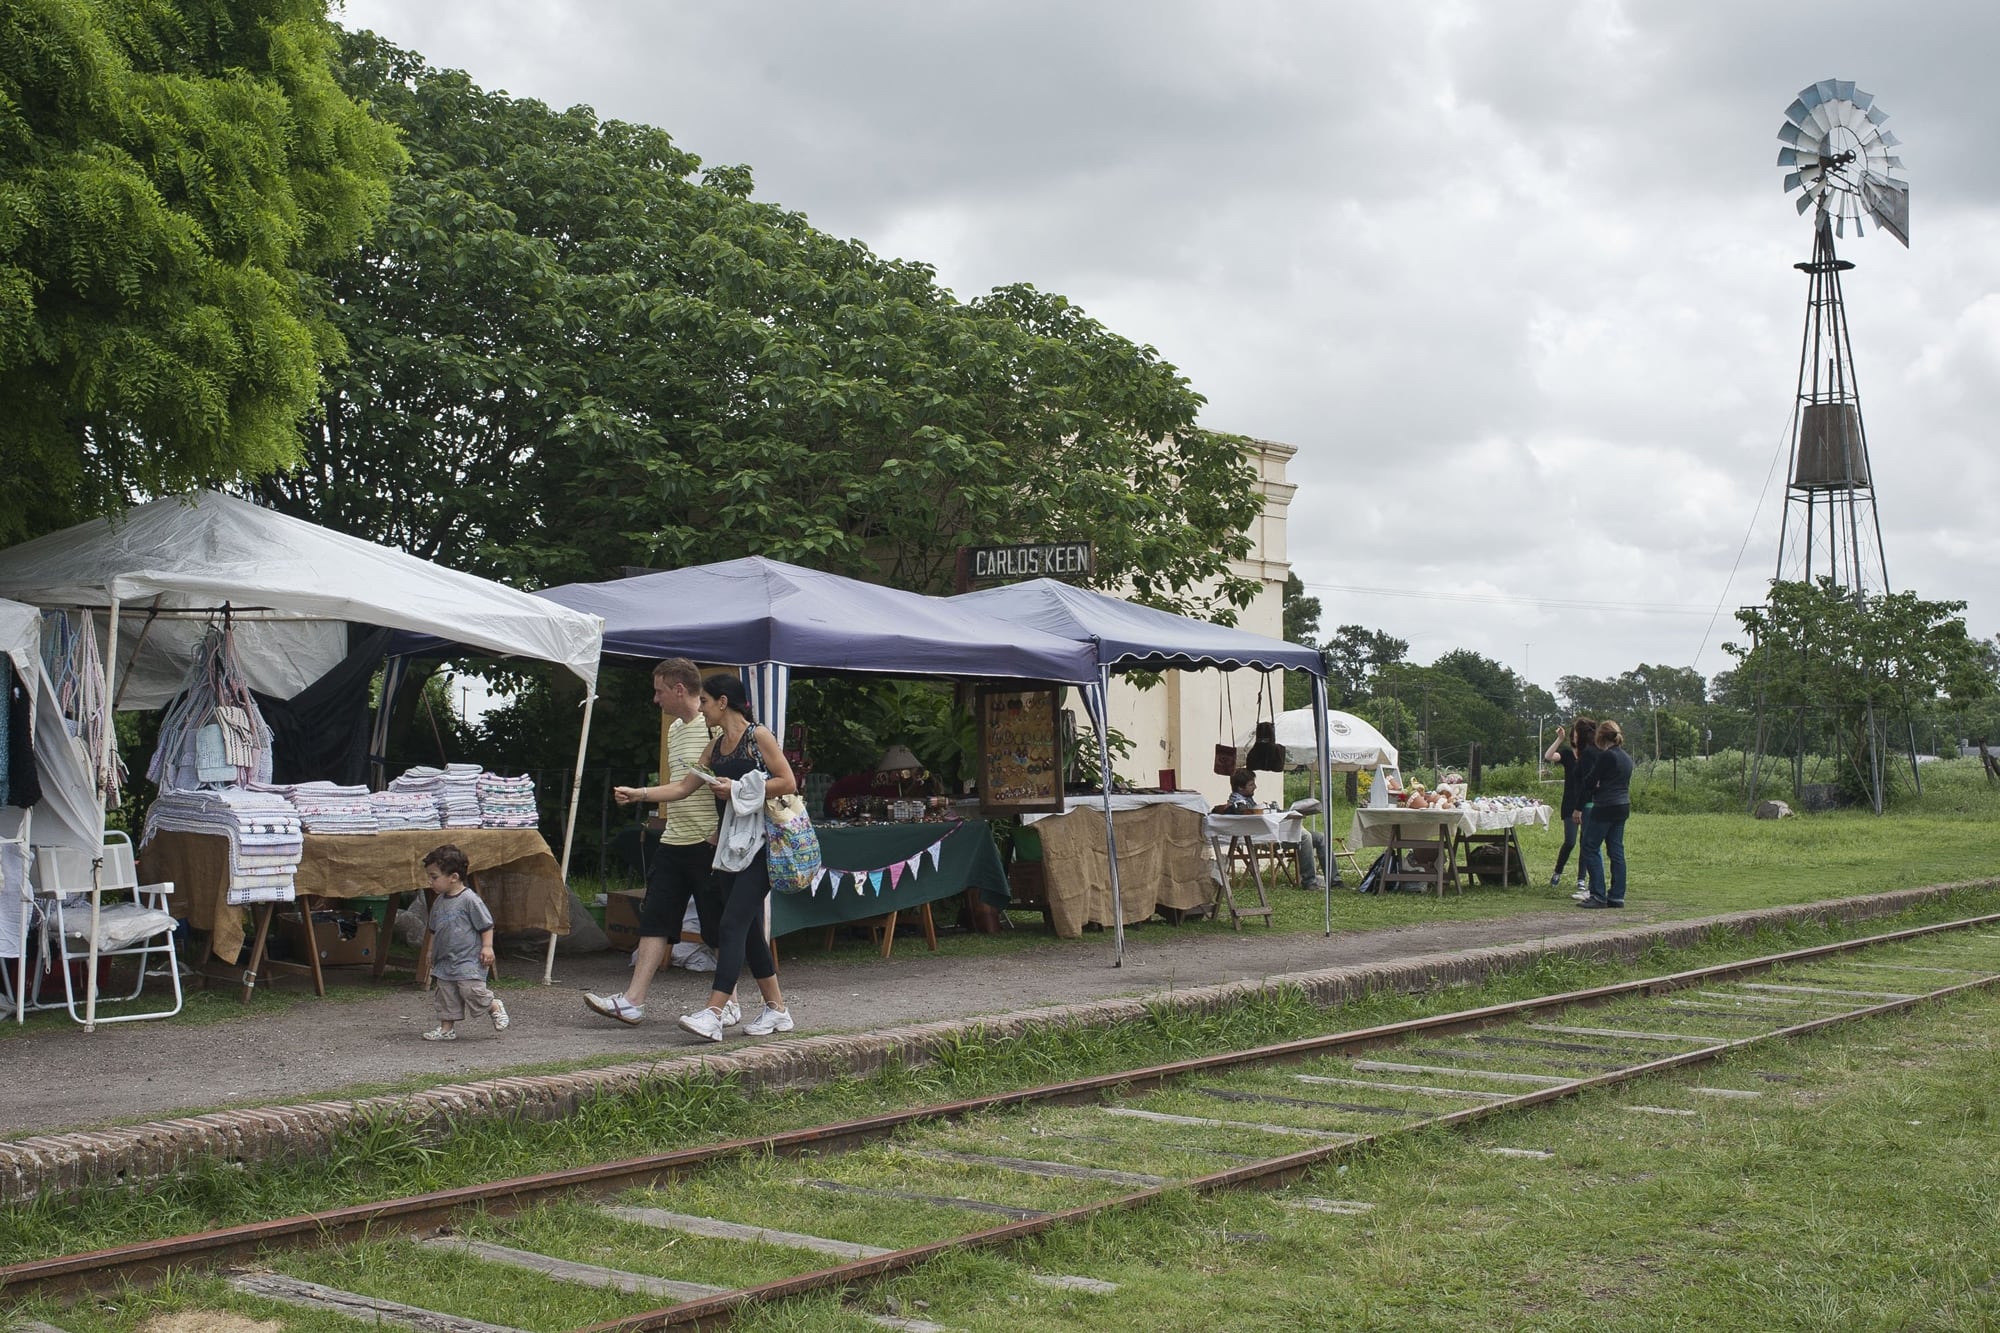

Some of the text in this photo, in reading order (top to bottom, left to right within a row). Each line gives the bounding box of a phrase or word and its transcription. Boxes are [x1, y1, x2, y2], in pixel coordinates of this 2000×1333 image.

[976, 546, 1088, 576] CARLOS KEEN
[1330, 750, 1374, 760] WARSTEINER
